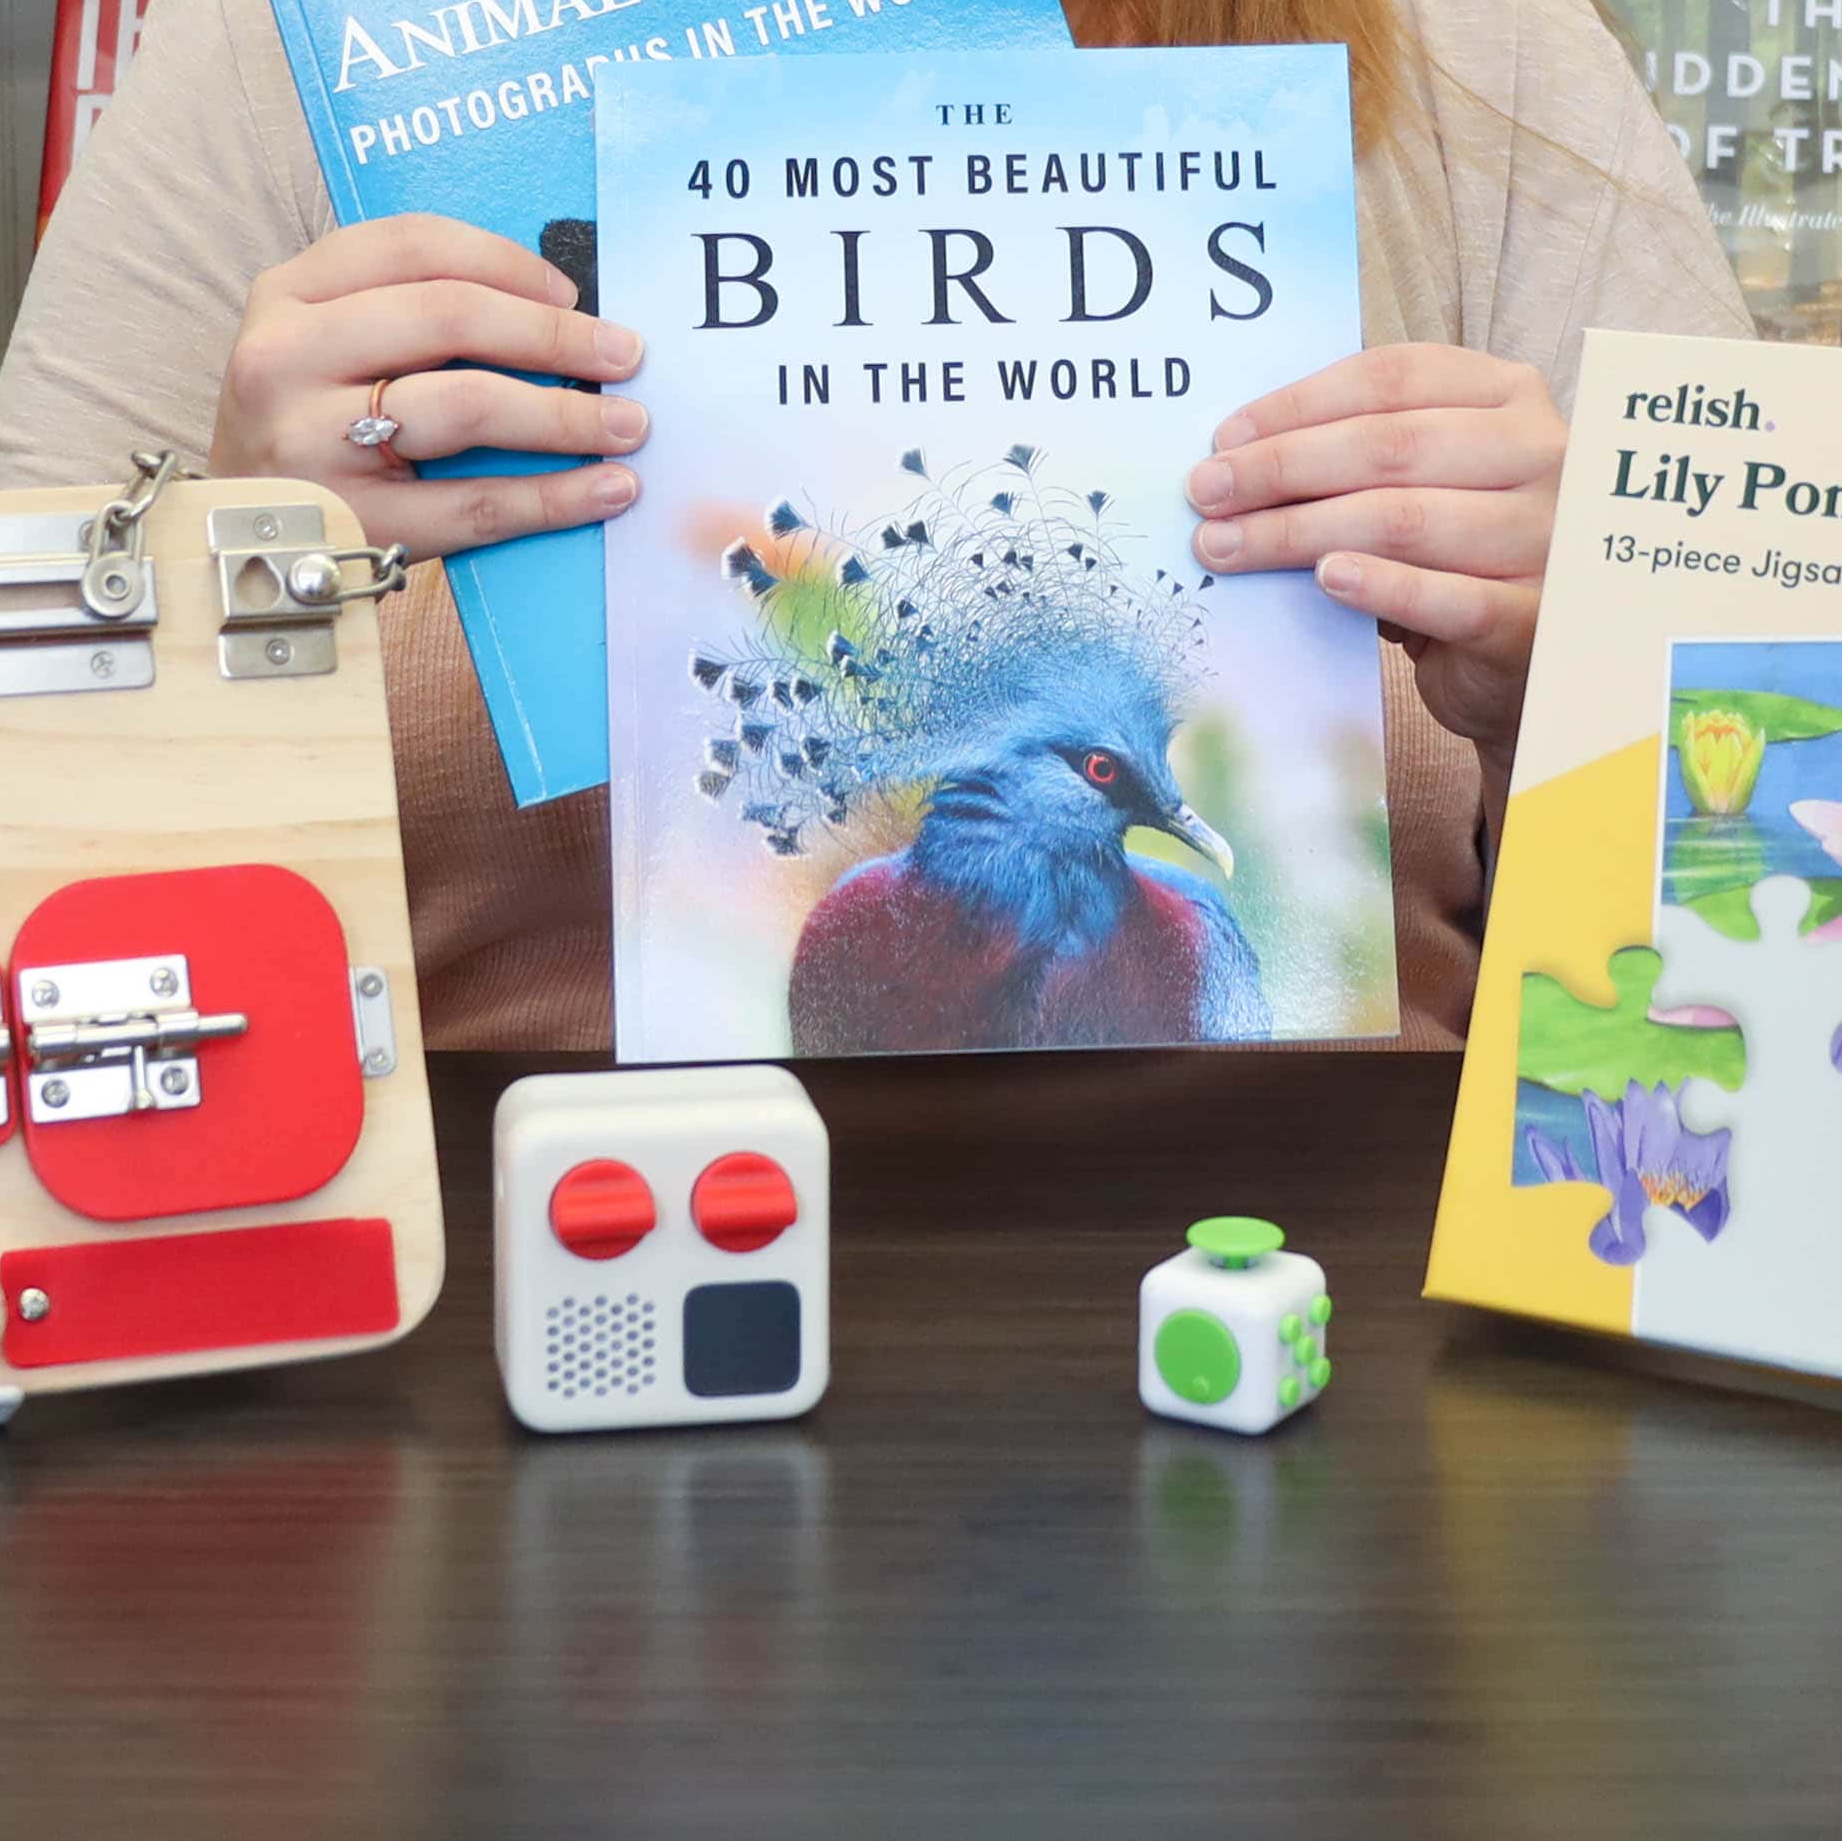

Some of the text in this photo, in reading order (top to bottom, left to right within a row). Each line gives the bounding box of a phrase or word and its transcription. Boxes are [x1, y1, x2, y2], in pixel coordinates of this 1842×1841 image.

[687, 15, 735, 60] IN
[935, 103, 1013, 127] THE
[687, 150, 1278, 199] 40 MOST BEAUTIFUL
[1707, 202, 1734, 227] he
[691, 221, 1273, 330] BIRDS
[778, 357, 1192, 405] IN THE WORLD
[1623, 384, 1776, 432] relish.
[1610, 450, 1725, 518] Lily
[1601, 534, 1740, 573] 13-piece
